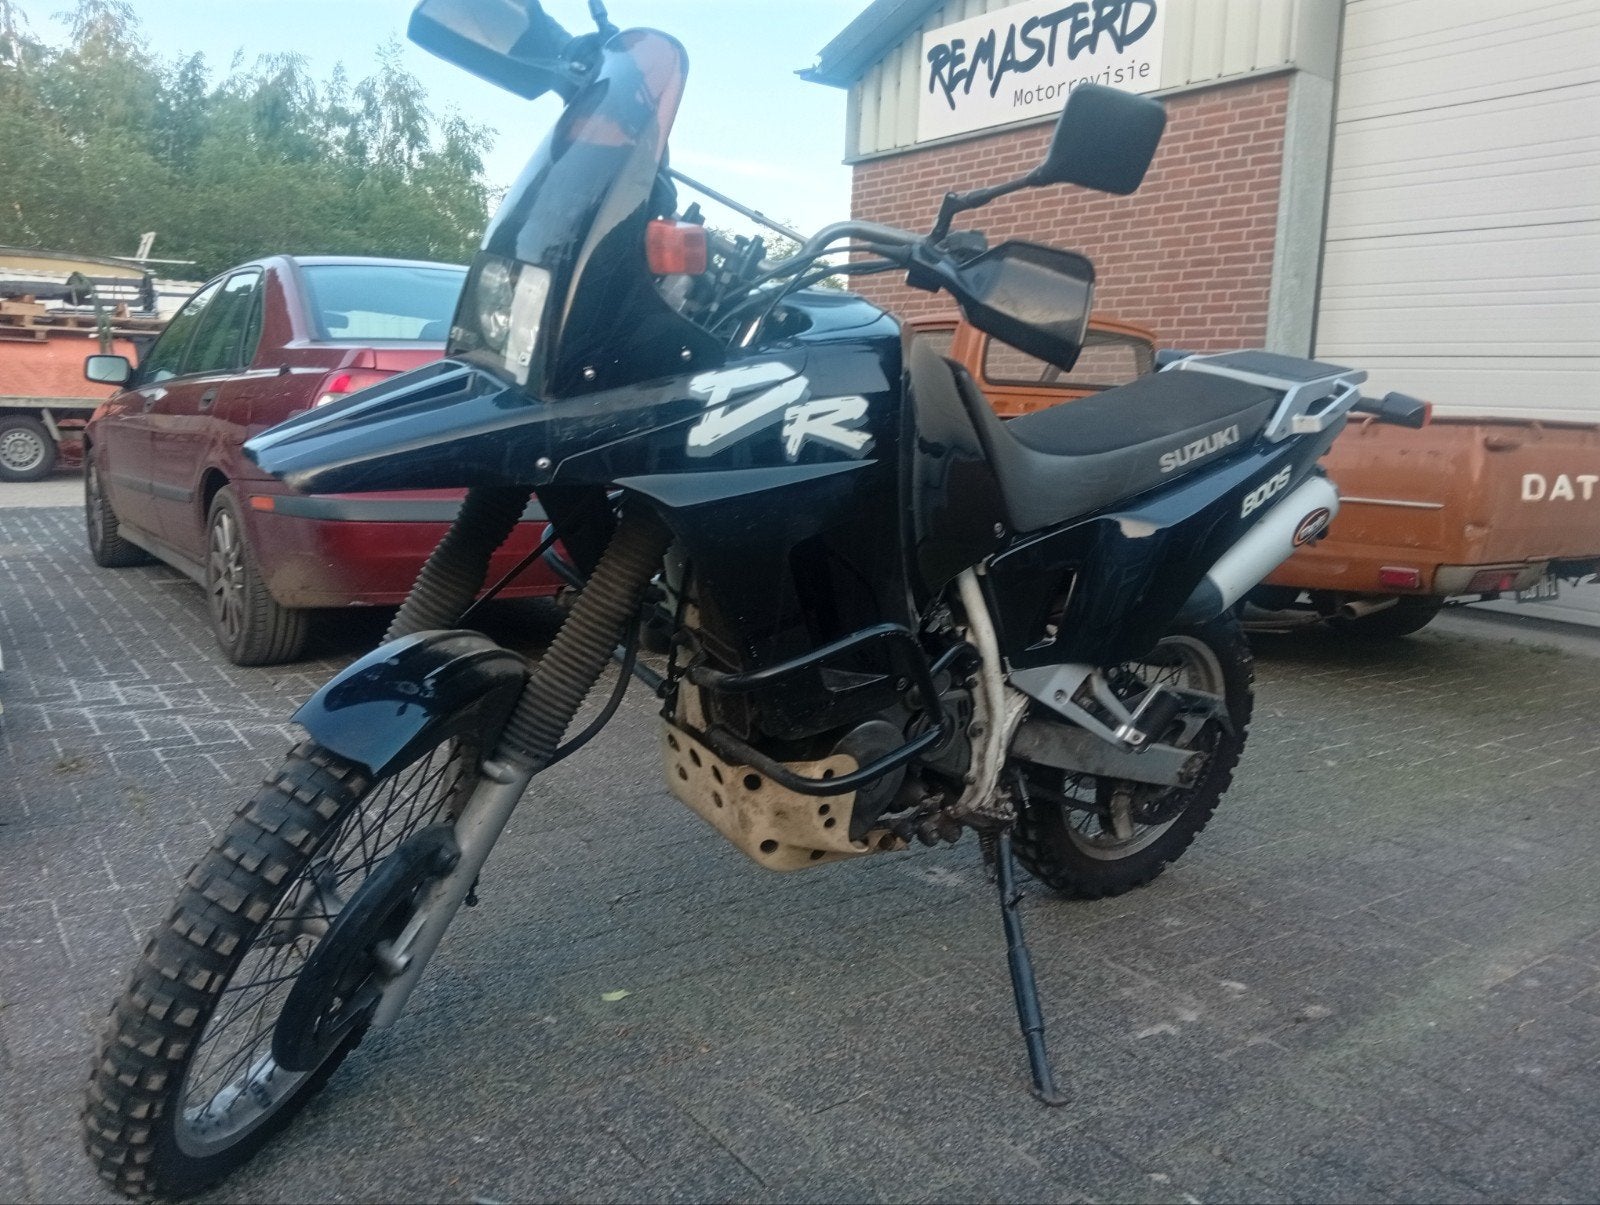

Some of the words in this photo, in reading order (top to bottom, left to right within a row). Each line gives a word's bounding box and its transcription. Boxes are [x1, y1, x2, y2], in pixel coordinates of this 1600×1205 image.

[927, 0, 1158, 111] REMASTERD
[687, 361, 873, 457] DR
[1159, 424, 1240, 473] SUZUKI
[1240, 464, 1293, 519] 800S
[1521, 473, 1600, 501] DAT
